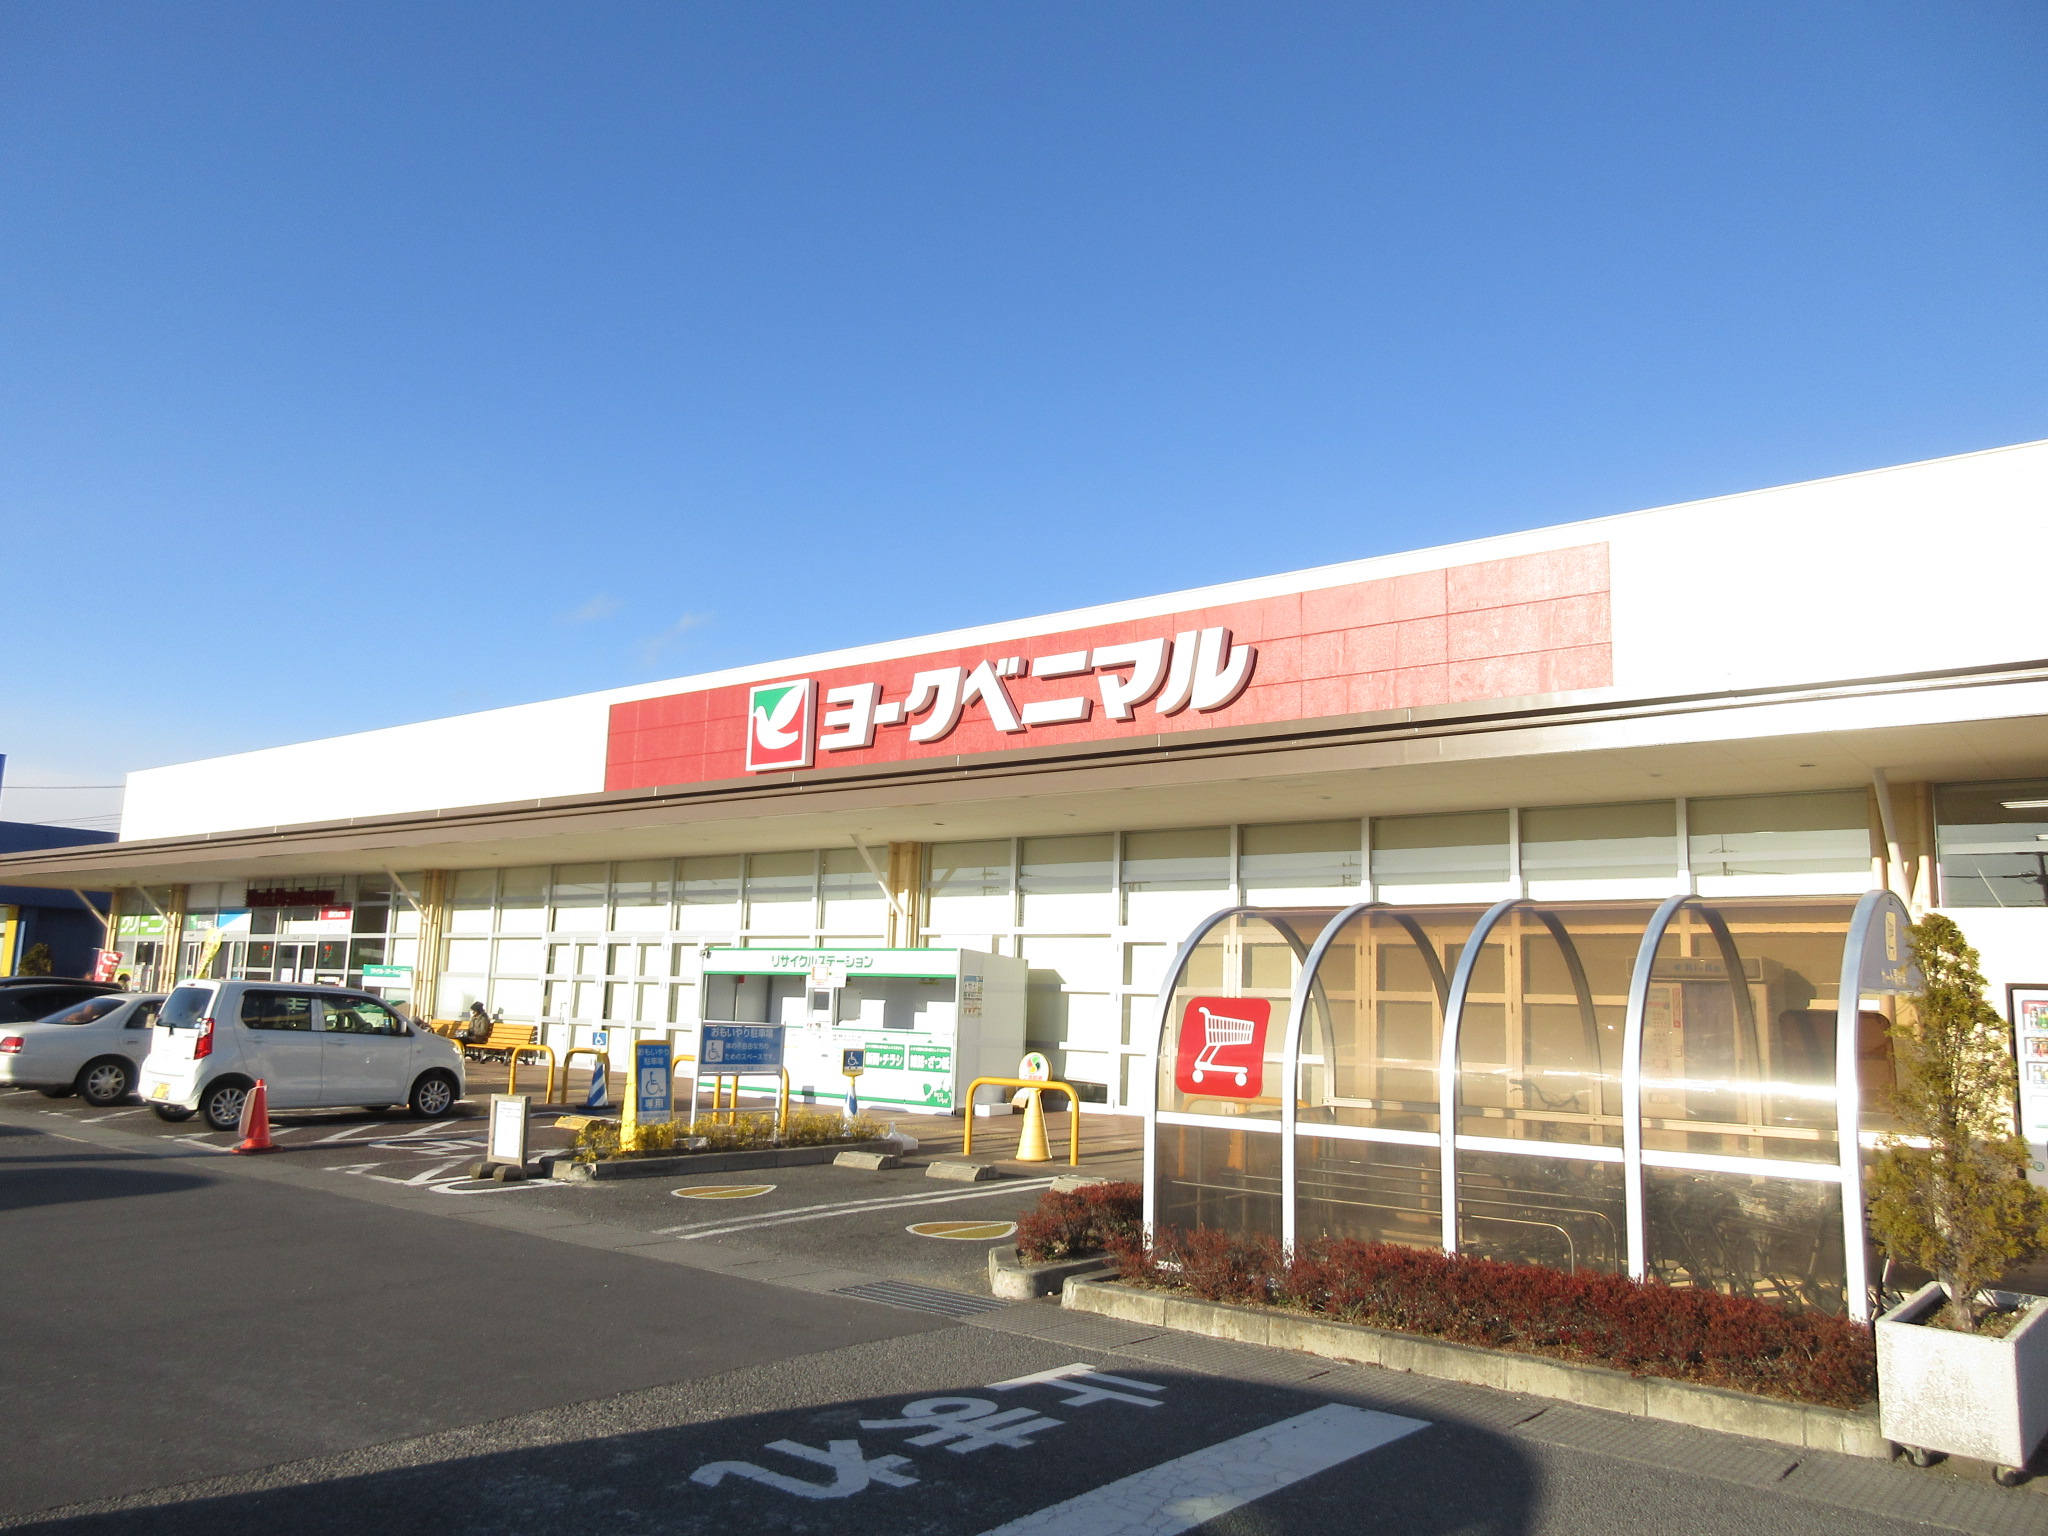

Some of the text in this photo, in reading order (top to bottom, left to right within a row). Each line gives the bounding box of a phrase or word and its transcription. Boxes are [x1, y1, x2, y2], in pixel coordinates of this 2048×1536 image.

[818, 626, 1256, 751] ヨークベニマル
[119, 914, 168, 933] クリーニン
[770, 954, 874, 969] リサイクルステーション
[710, 1027, 775, 1040] おもいやり駐車場
[637, 1047, 671, 1057] おもいやり
[644, 1098, 665, 1110] 専用
[689, 1362, 1168, 1500] 止まれ
